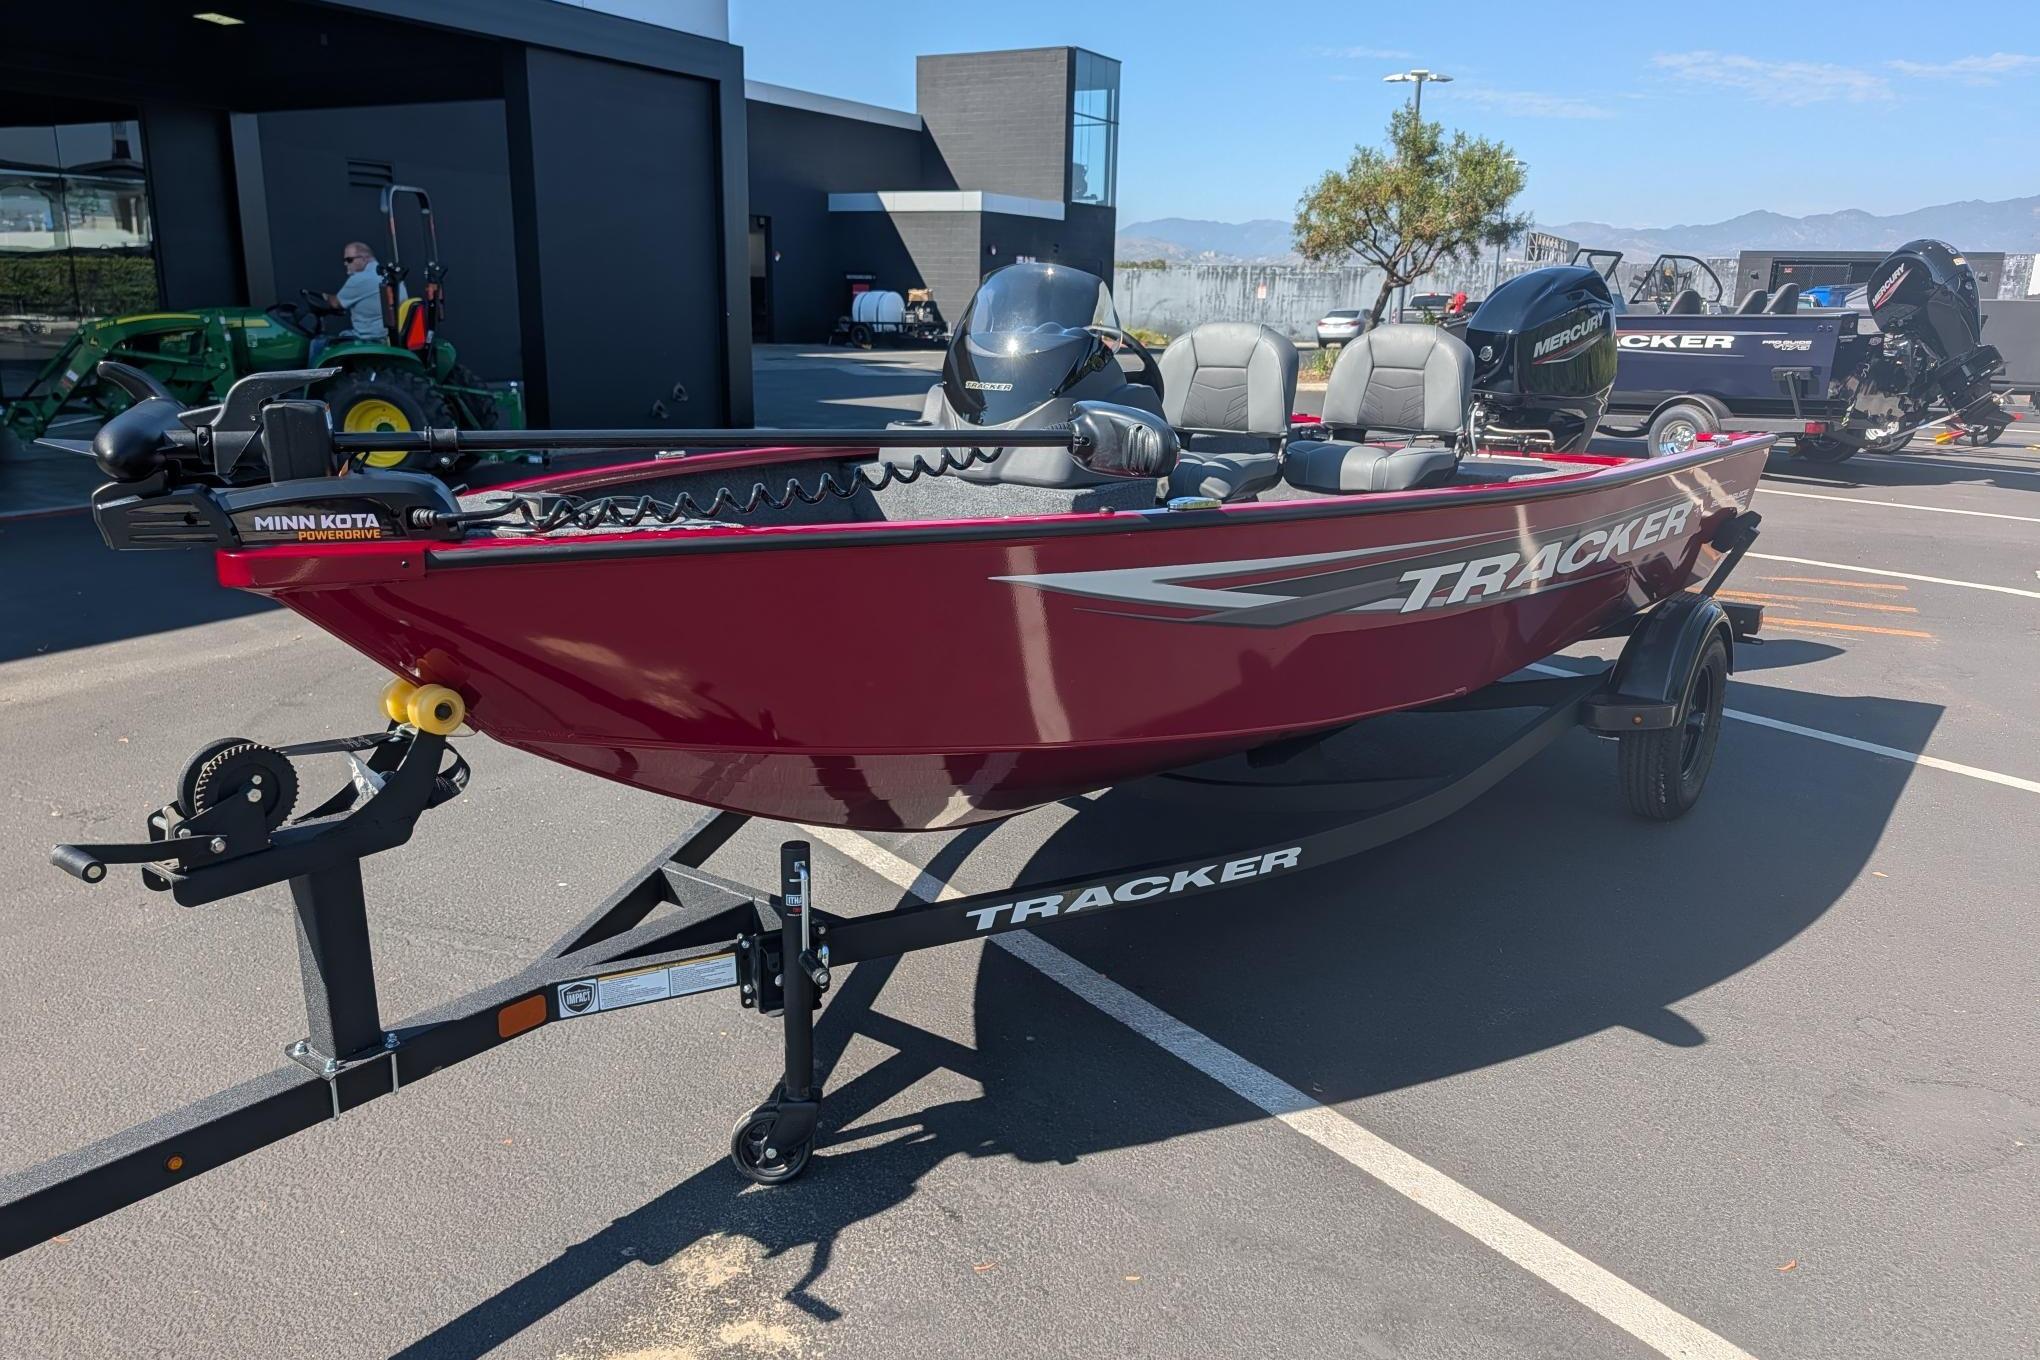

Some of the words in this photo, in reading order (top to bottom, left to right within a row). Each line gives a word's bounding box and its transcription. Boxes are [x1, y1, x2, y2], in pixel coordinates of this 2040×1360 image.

[1872, 263, 1905, 306] MERCURY
[1533, 309, 1605, 358] MERCURY
[1616, 334, 1735, 349] CKER
[966, 381, 1012, 391] TRACKER
[254, 514, 315, 531] MINN
[320, 513, 381, 528] KOTA
[298, 528, 382, 541] POWERDRIVE
[1400, 500, 1695, 614] TRACKER
[966, 846, 1302, 931] TRACKER
[566, 990, 591, 1005] IMPACT
